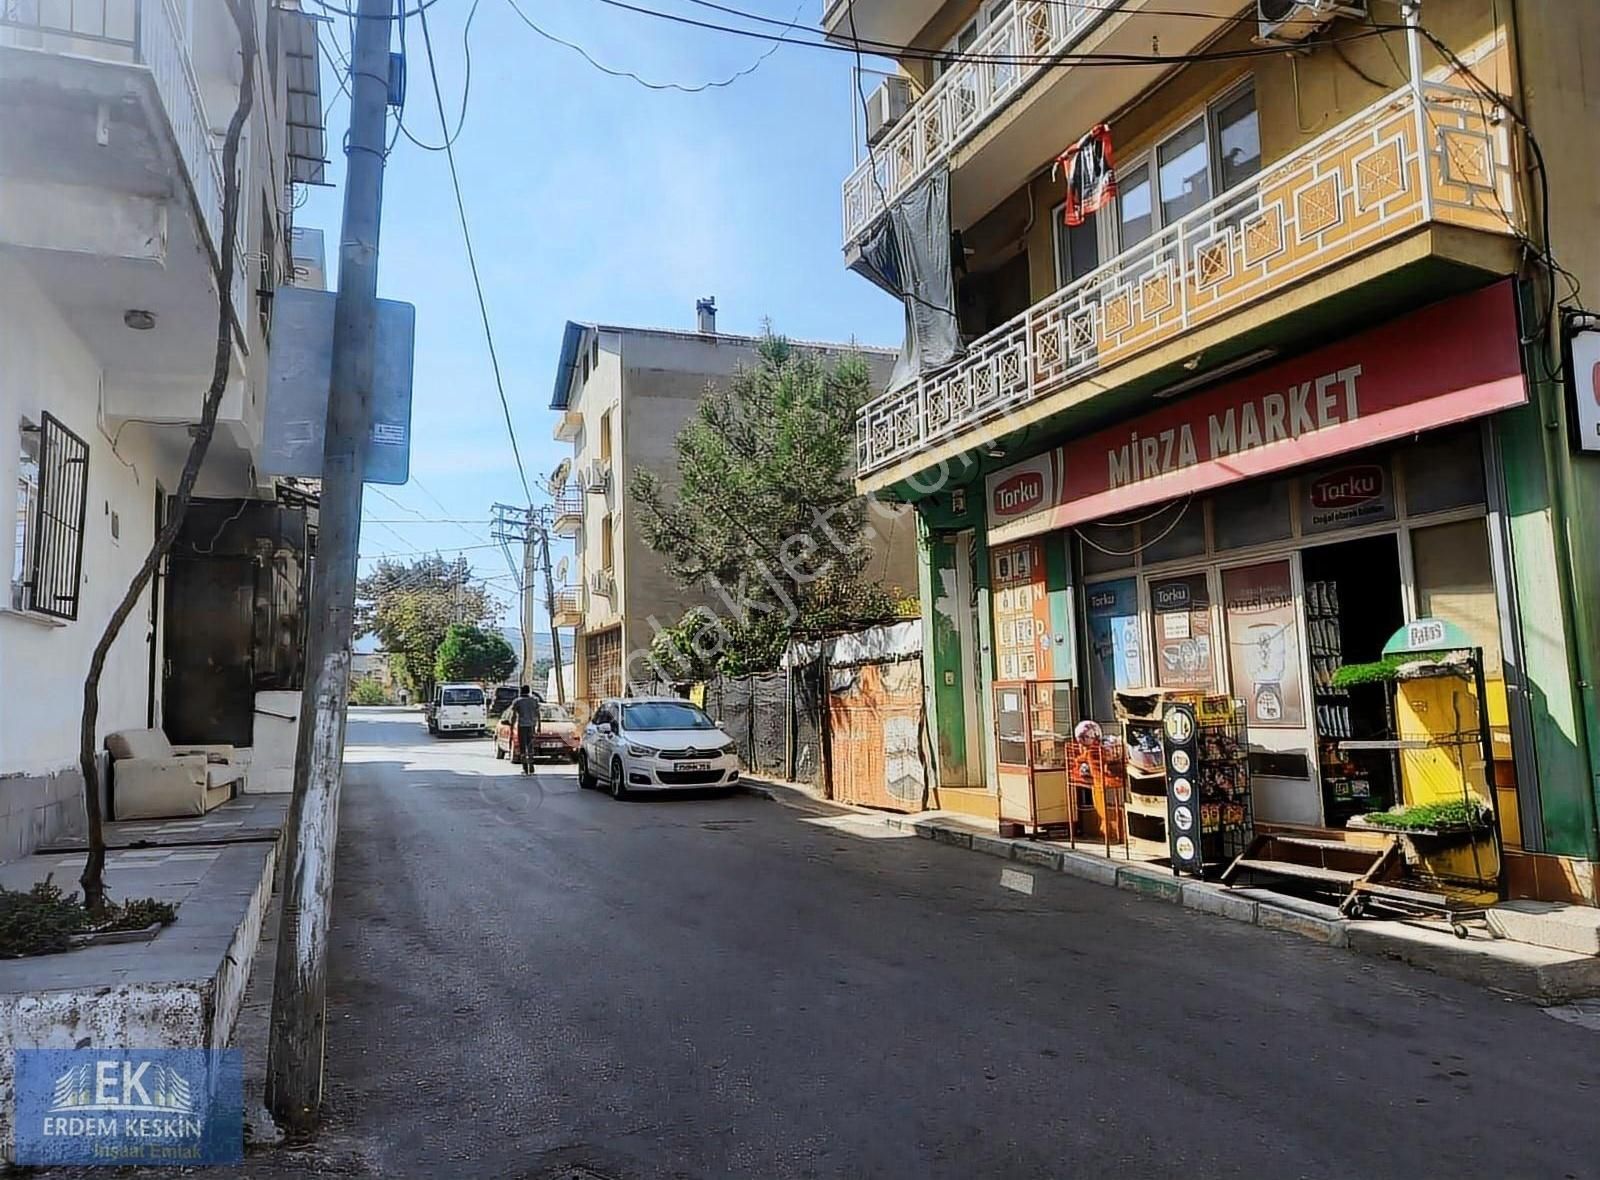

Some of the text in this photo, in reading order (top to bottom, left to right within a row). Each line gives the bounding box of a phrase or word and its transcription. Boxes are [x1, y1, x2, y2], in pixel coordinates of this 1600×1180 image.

[1108, 364, 1362, 489] MİRZA MARKET
[997, 480, 1038, 510] Torku
[1316, 476, 1374, 502] Torku
[1091, 593, 1115, 608] Torku
[1157, 588, 1185, 602] Torku
